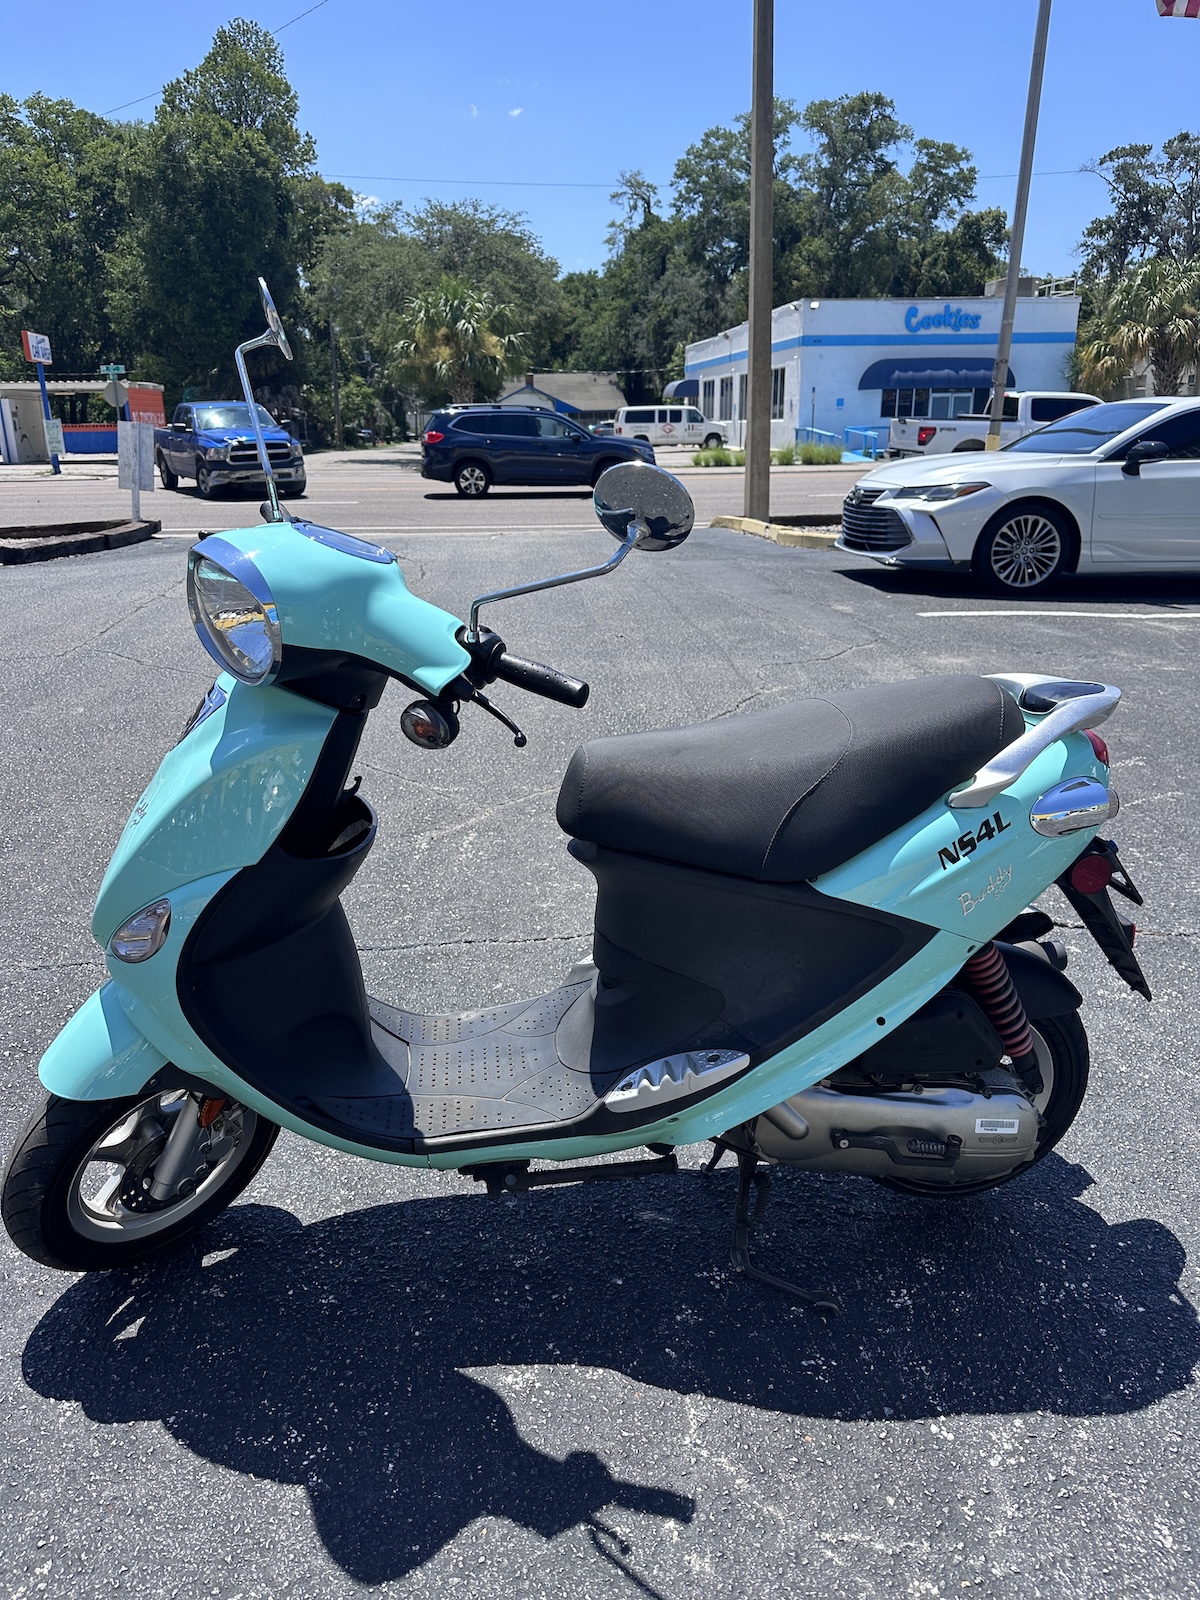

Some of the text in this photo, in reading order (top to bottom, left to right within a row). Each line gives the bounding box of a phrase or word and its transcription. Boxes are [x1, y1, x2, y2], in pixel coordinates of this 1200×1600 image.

[905, 304, 982, 333] Cookies
[937, 811, 1012, 871] NS4L
[958, 863, 1013, 917] Buddy
